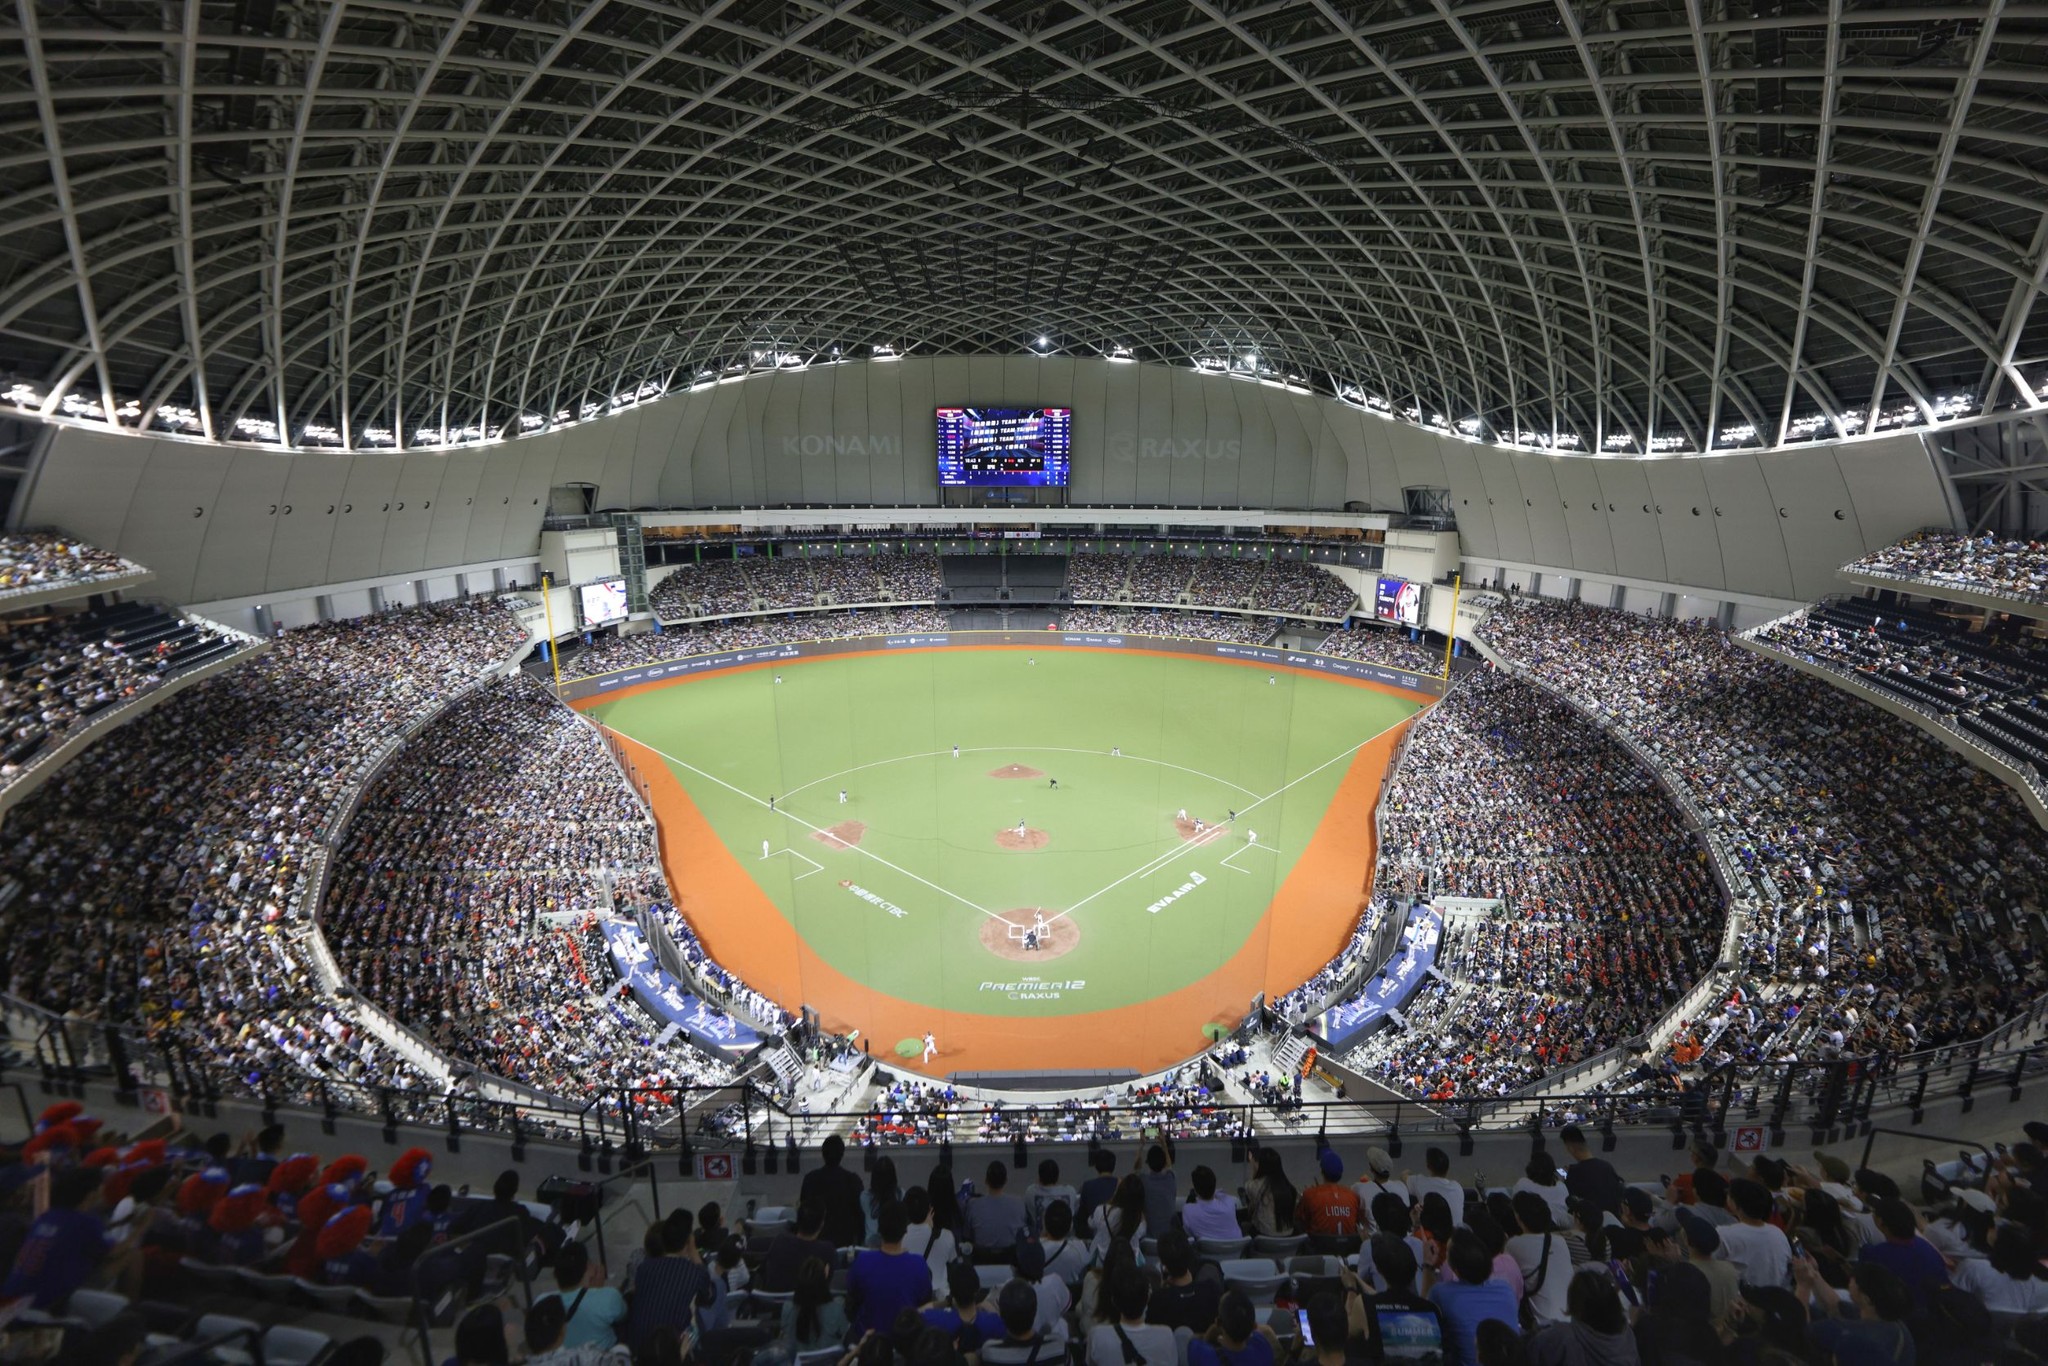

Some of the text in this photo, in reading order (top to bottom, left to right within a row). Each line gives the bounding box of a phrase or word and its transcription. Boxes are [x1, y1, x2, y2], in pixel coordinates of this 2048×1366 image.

[782, 434, 901, 456] KONAMI
[1139, 437, 1241, 460] RAXUS
[1146, 882, 1197, 914] EVA AIR
[1020, 992, 1060, 1000] RAXUS
[1325, 1205, 1351, 1217] LIONS
